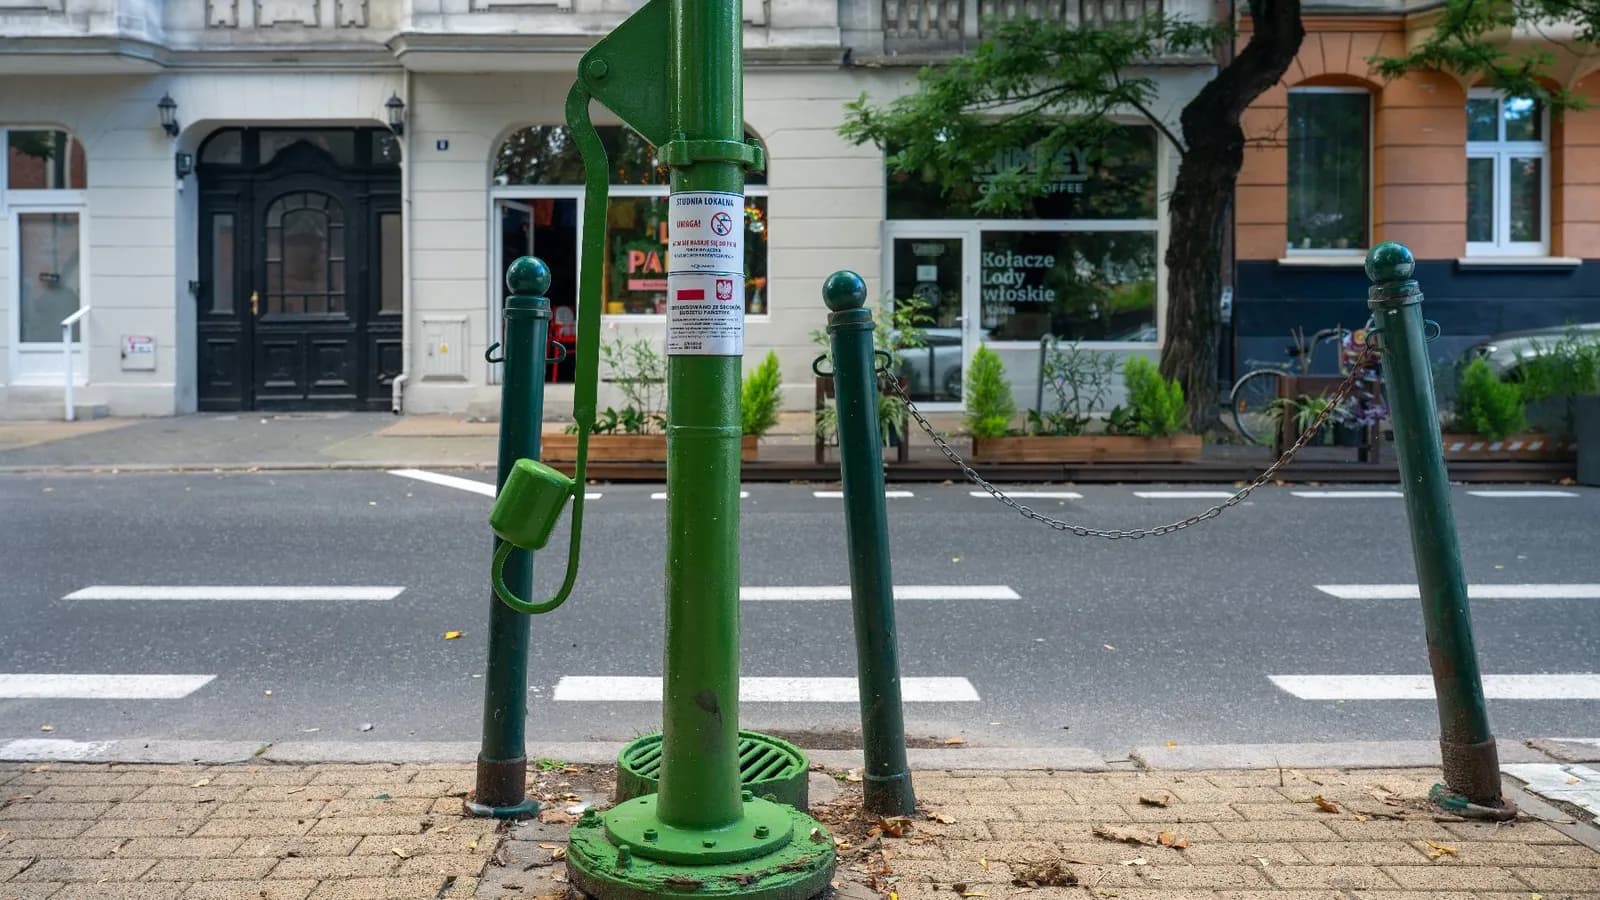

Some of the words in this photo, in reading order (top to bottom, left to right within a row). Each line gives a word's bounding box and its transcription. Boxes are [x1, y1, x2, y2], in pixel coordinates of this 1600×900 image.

[1032, 183, 1083, 193] OFFEE
[676, 197, 703, 206] STUDNIA
[704, 197, 734, 207] LOKALNA
[676, 219, 701, 228] UWAGA!
[982, 250, 1055, 268] Kołacze
[982, 268, 1026, 288] Lody
[983, 285, 1055, 302] włoskie
